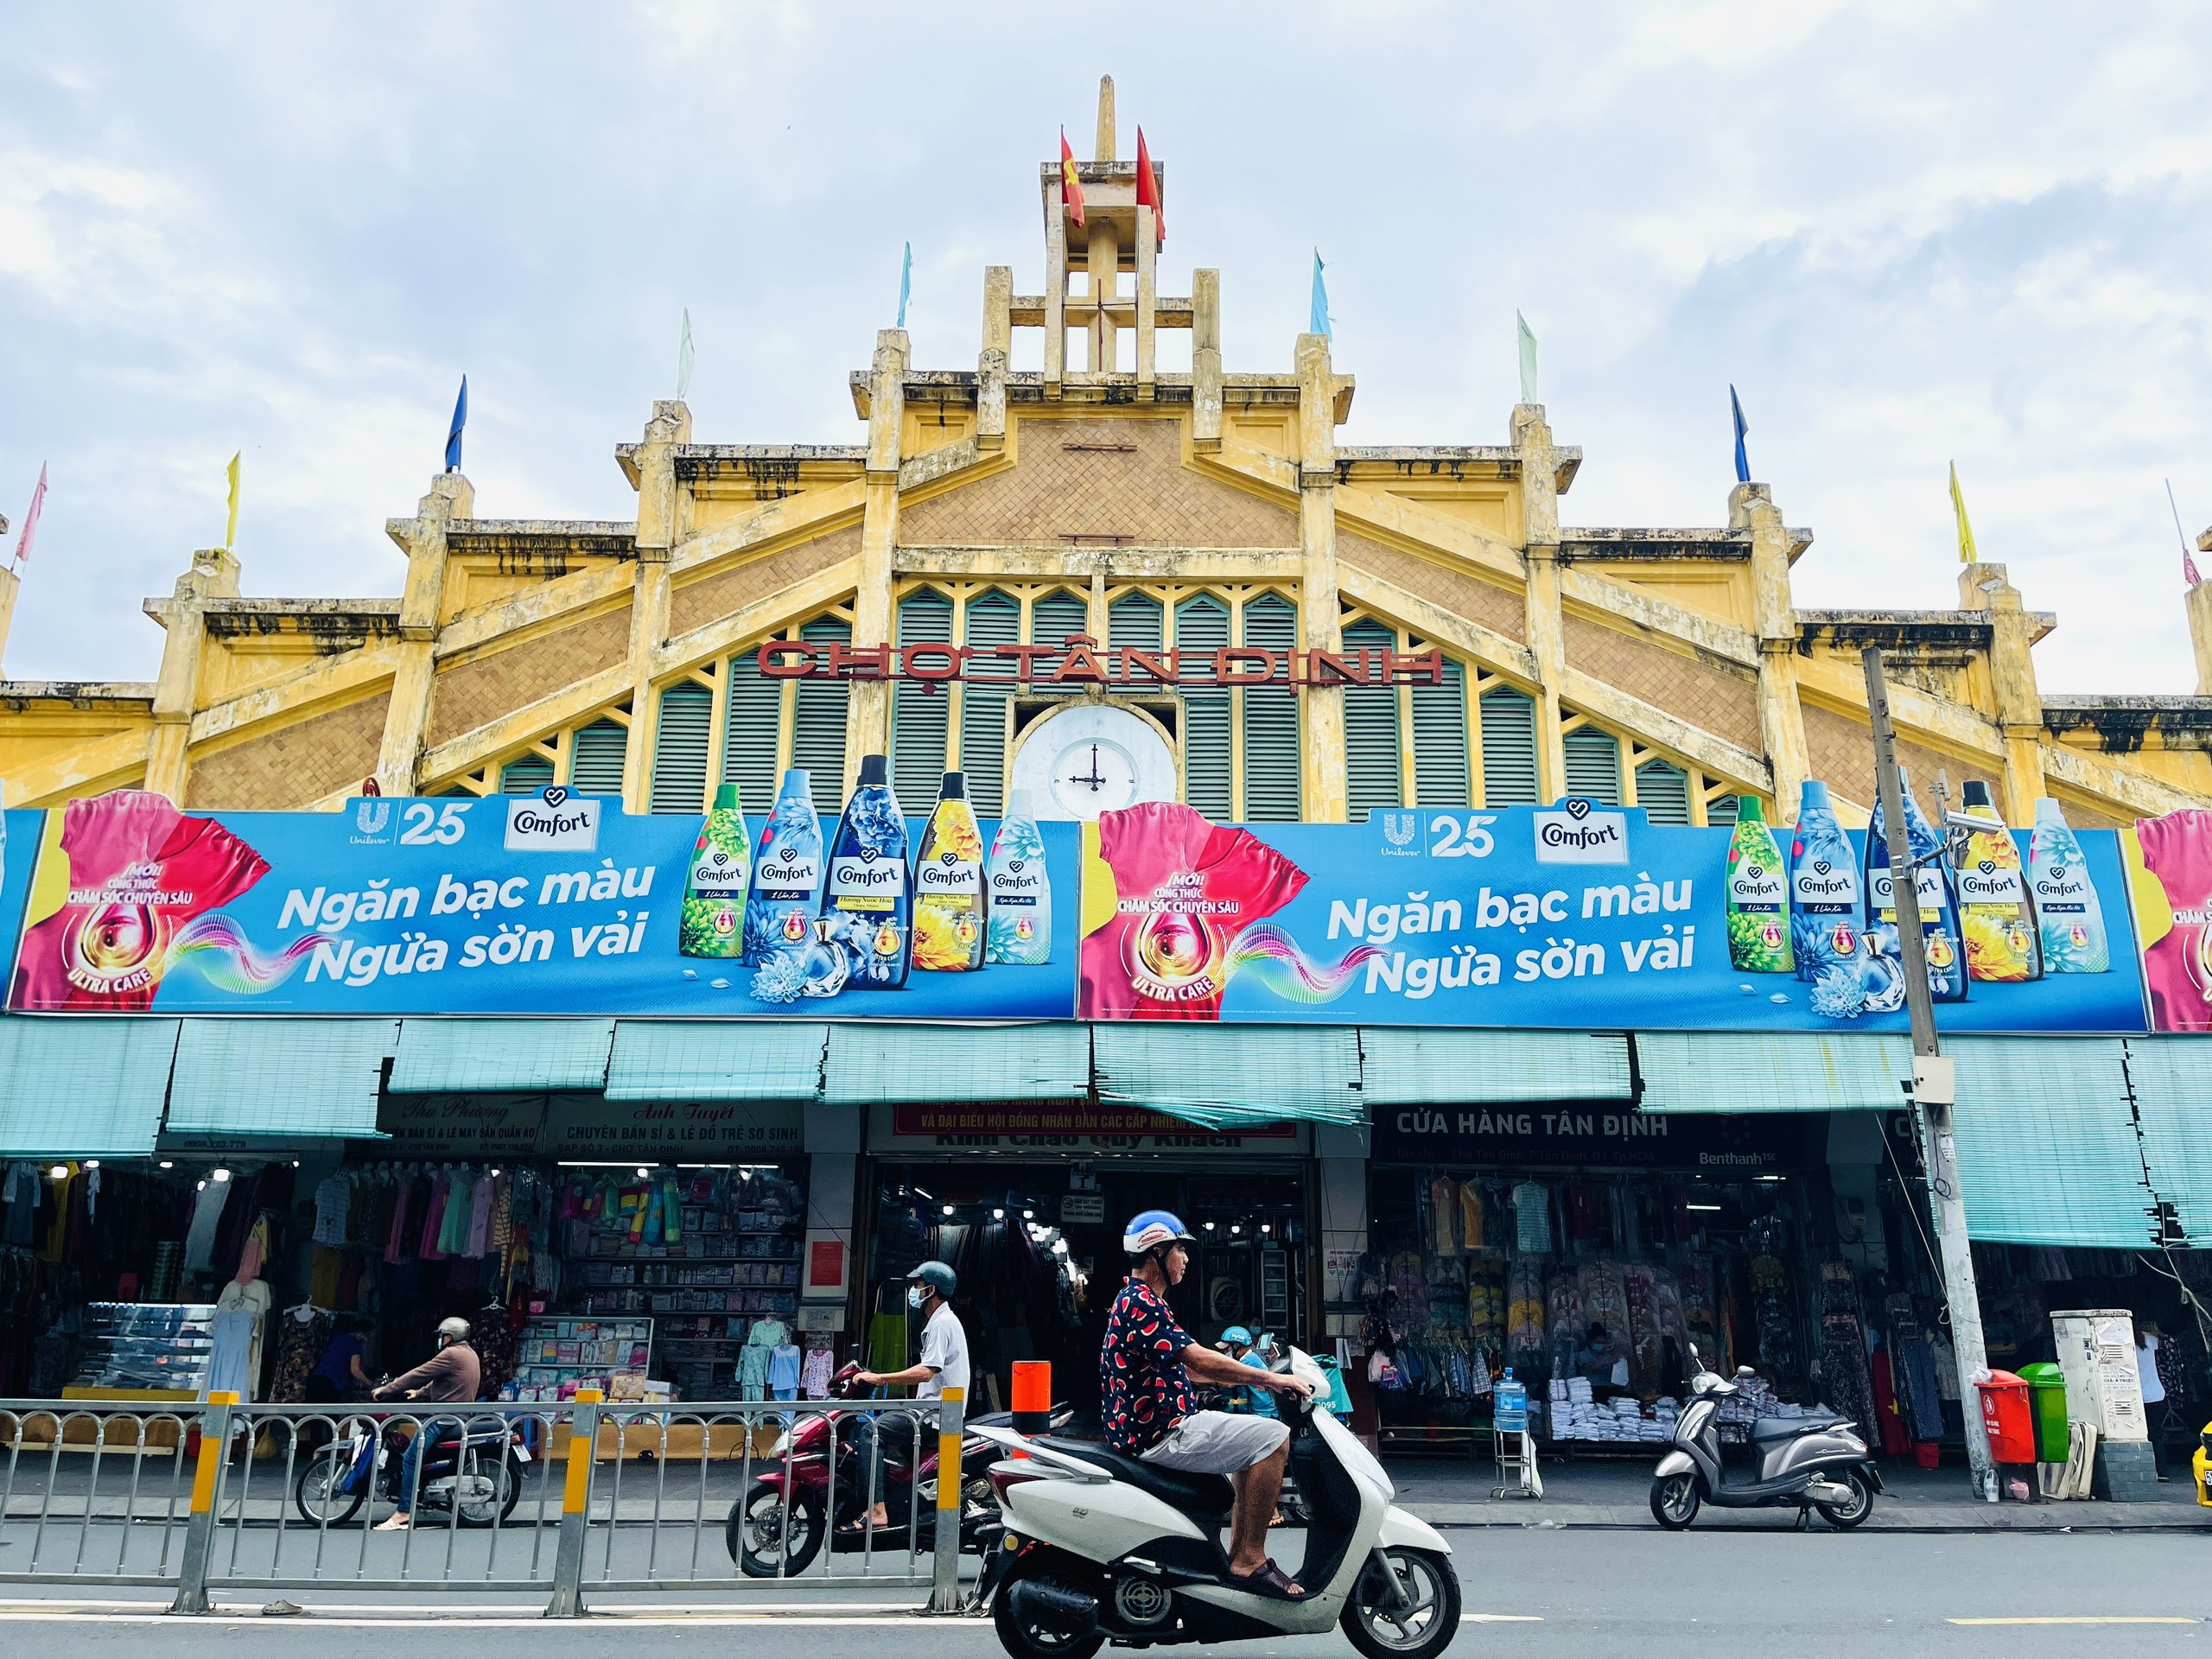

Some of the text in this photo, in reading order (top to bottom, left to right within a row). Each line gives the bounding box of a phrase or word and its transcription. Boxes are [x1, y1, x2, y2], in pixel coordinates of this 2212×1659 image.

[758, 634, 1443, 696] CHỢ TÂN ĐỊNH
[400, 803, 474, 845] 25
[514, 810, 590, 836] Comfort
[349, 836, 391, 844] Unilever
[1431, 815, 1497, 857] 25
[1541, 823, 1618, 849] Comfort
[1381, 847, 1421, 856] Unilever
[696, 867, 741, 882] Comfort
[761, 864, 813, 881] Comfort
[836, 865, 898, 887] Comfort
[923, 868, 975, 886] Comfort
[994, 874, 1039, 889] Comfort
[1734, 880, 1780, 896] Comfort
[1798, 877, 1851, 895] Comfort
[1875, 877, 1938, 896] Cort
[1963, 877, 2017, 894] Comfort
[2037, 880, 2083, 896] Comfort
[67, 889, 193, 905] CHĂM SÓC CHUYÊN SÂU
[276, 859, 657, 933] Ngăn bạc màu
[1117, 899, 1240, 913] CHĂM SÓC CHUYÊN SÂU
[1326, 871, 1693, 944] Ngăn bạc màu
[304, 910, 649, 987] Ngừa sờn vải
[1364, 925, 1695, 999] Ngừa sờn vải
[67, 967, 152, 994] ULTRA CARE
[1132, 976, 1215, 1001] ULTRA CARE
[632, 1103, 734, 1122] Anh Tuyết
[921, 1111, 935, 1128] VÀ
[938, 1114, 957, 1130] ĐẠI
[987, 1113, 1006, 1130] HỘI
[1041, 1112, 1071, 1128] NHÂN
[1101, 1112, 1122, 1128] CÁC
[438, 1128, 443, 1138] &
[459, 1128, 476, 1138] MAY
[524, 1125, 535, 1138] ÁO
[566, 1123, 617, 1140] CHUYÊN
[621, 1123, 646, 1140] BÁN
[666, 1127, 676, 1140] &
[698, 1123, 716, 1140] ĐỒ
[721, 1125, 743, 1140] TRẺ
[747, 1127, 765, 1140] SƠ
[768, 1127, 798, 1140] SINH
[1396, 1107, 1668, 1141] CỬA HÀNG TÂN ĐỊNH
[637, 1143, 657, 1154] TÂN
[1700, 1152, 1762, 1165] Benthanh
